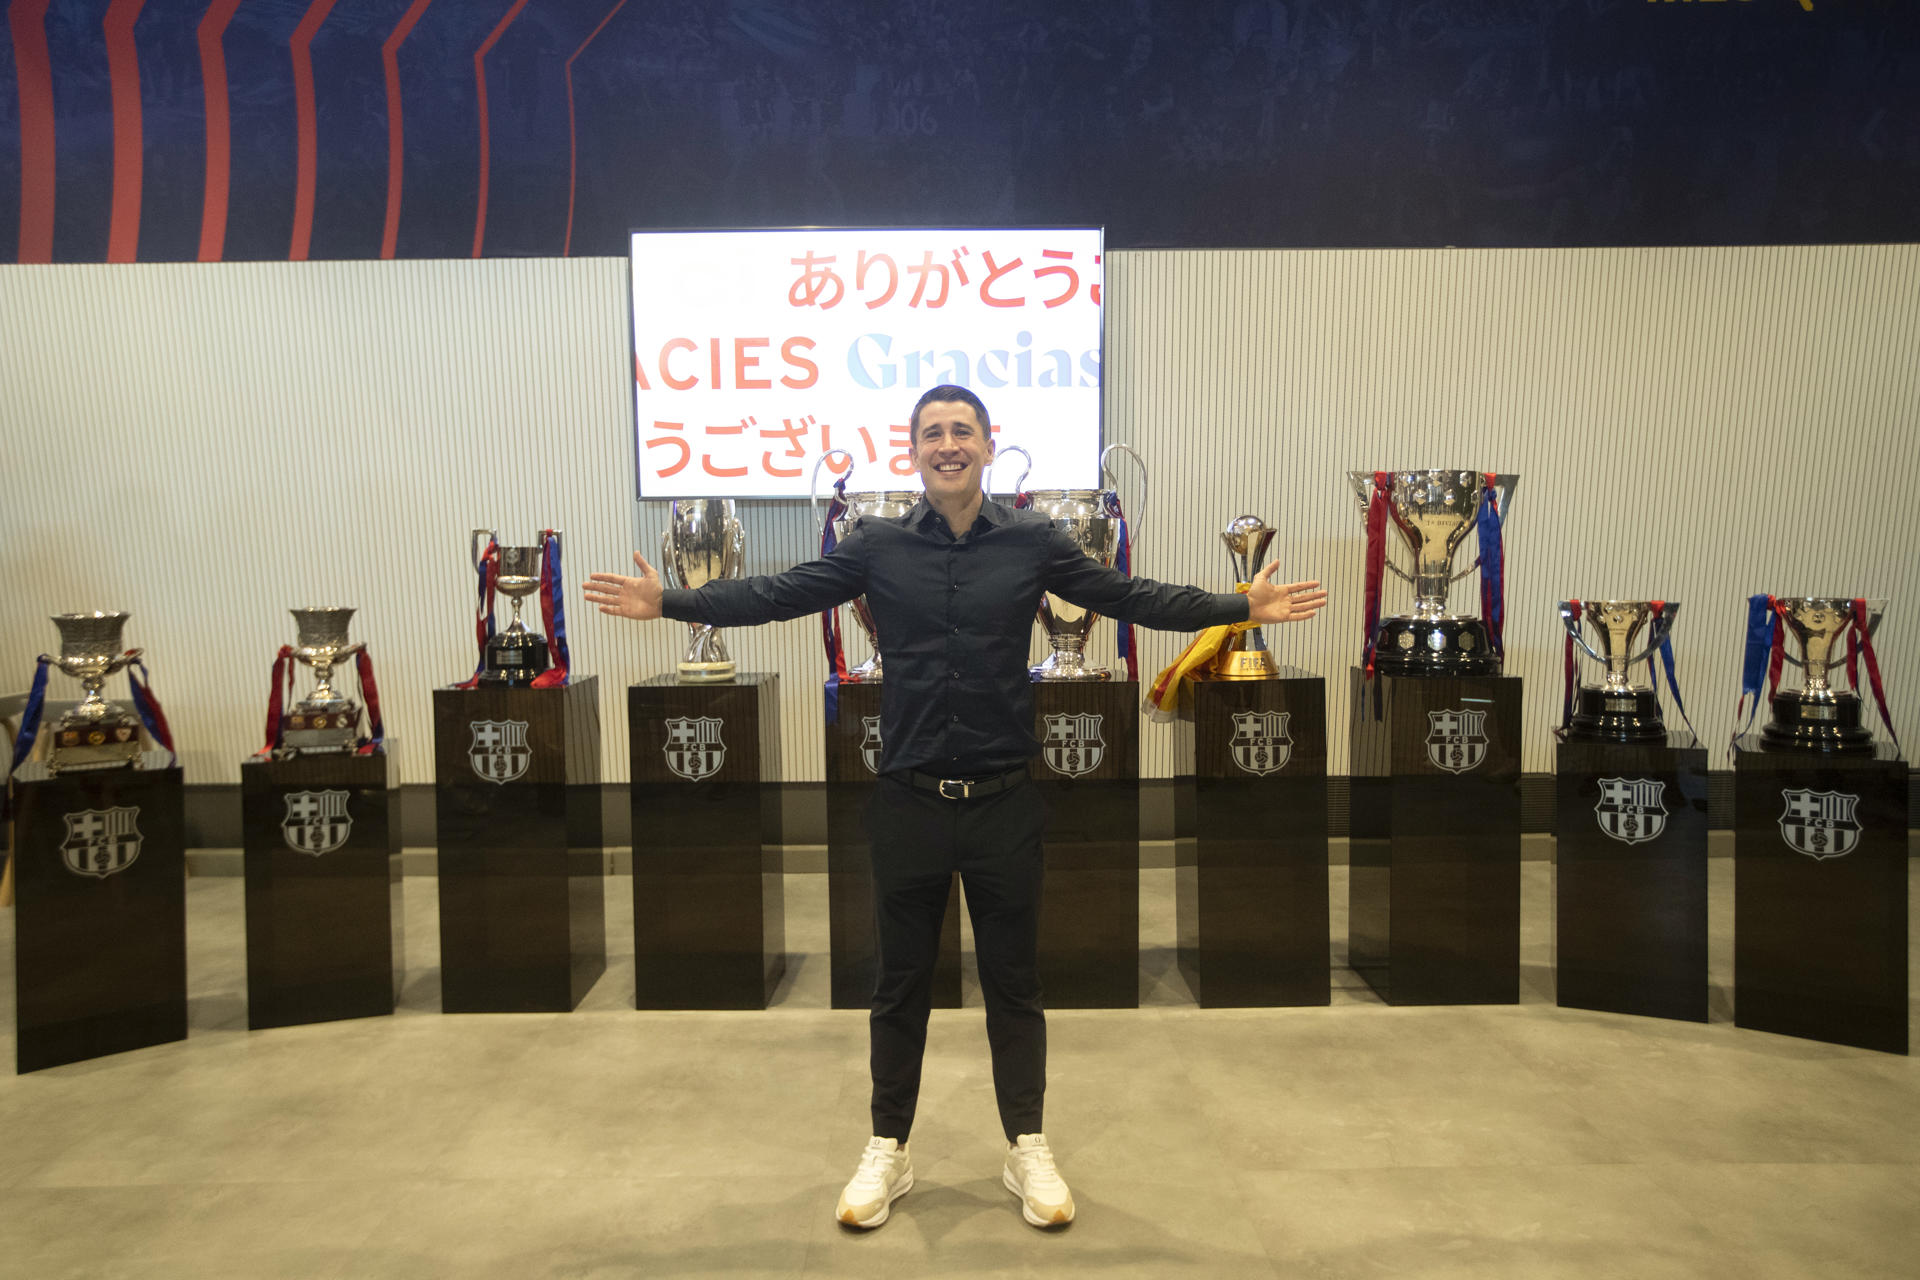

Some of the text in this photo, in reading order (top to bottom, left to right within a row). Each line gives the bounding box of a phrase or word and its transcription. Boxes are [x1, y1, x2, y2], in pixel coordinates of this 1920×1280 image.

[788, 246, 1100, 310] ありがとう
[847, 330, 1100, 390] Gracias
[646, 414, 1000, 479] うございま
[1240, 656, 1265, 669] FIFA
[1062, 740, 1085, 748] FCB
[1250, 738, 1274, 746] FCB
[1618, 805, 1645, 815] FCB
[1805, 819, 1835, 828] FCB
